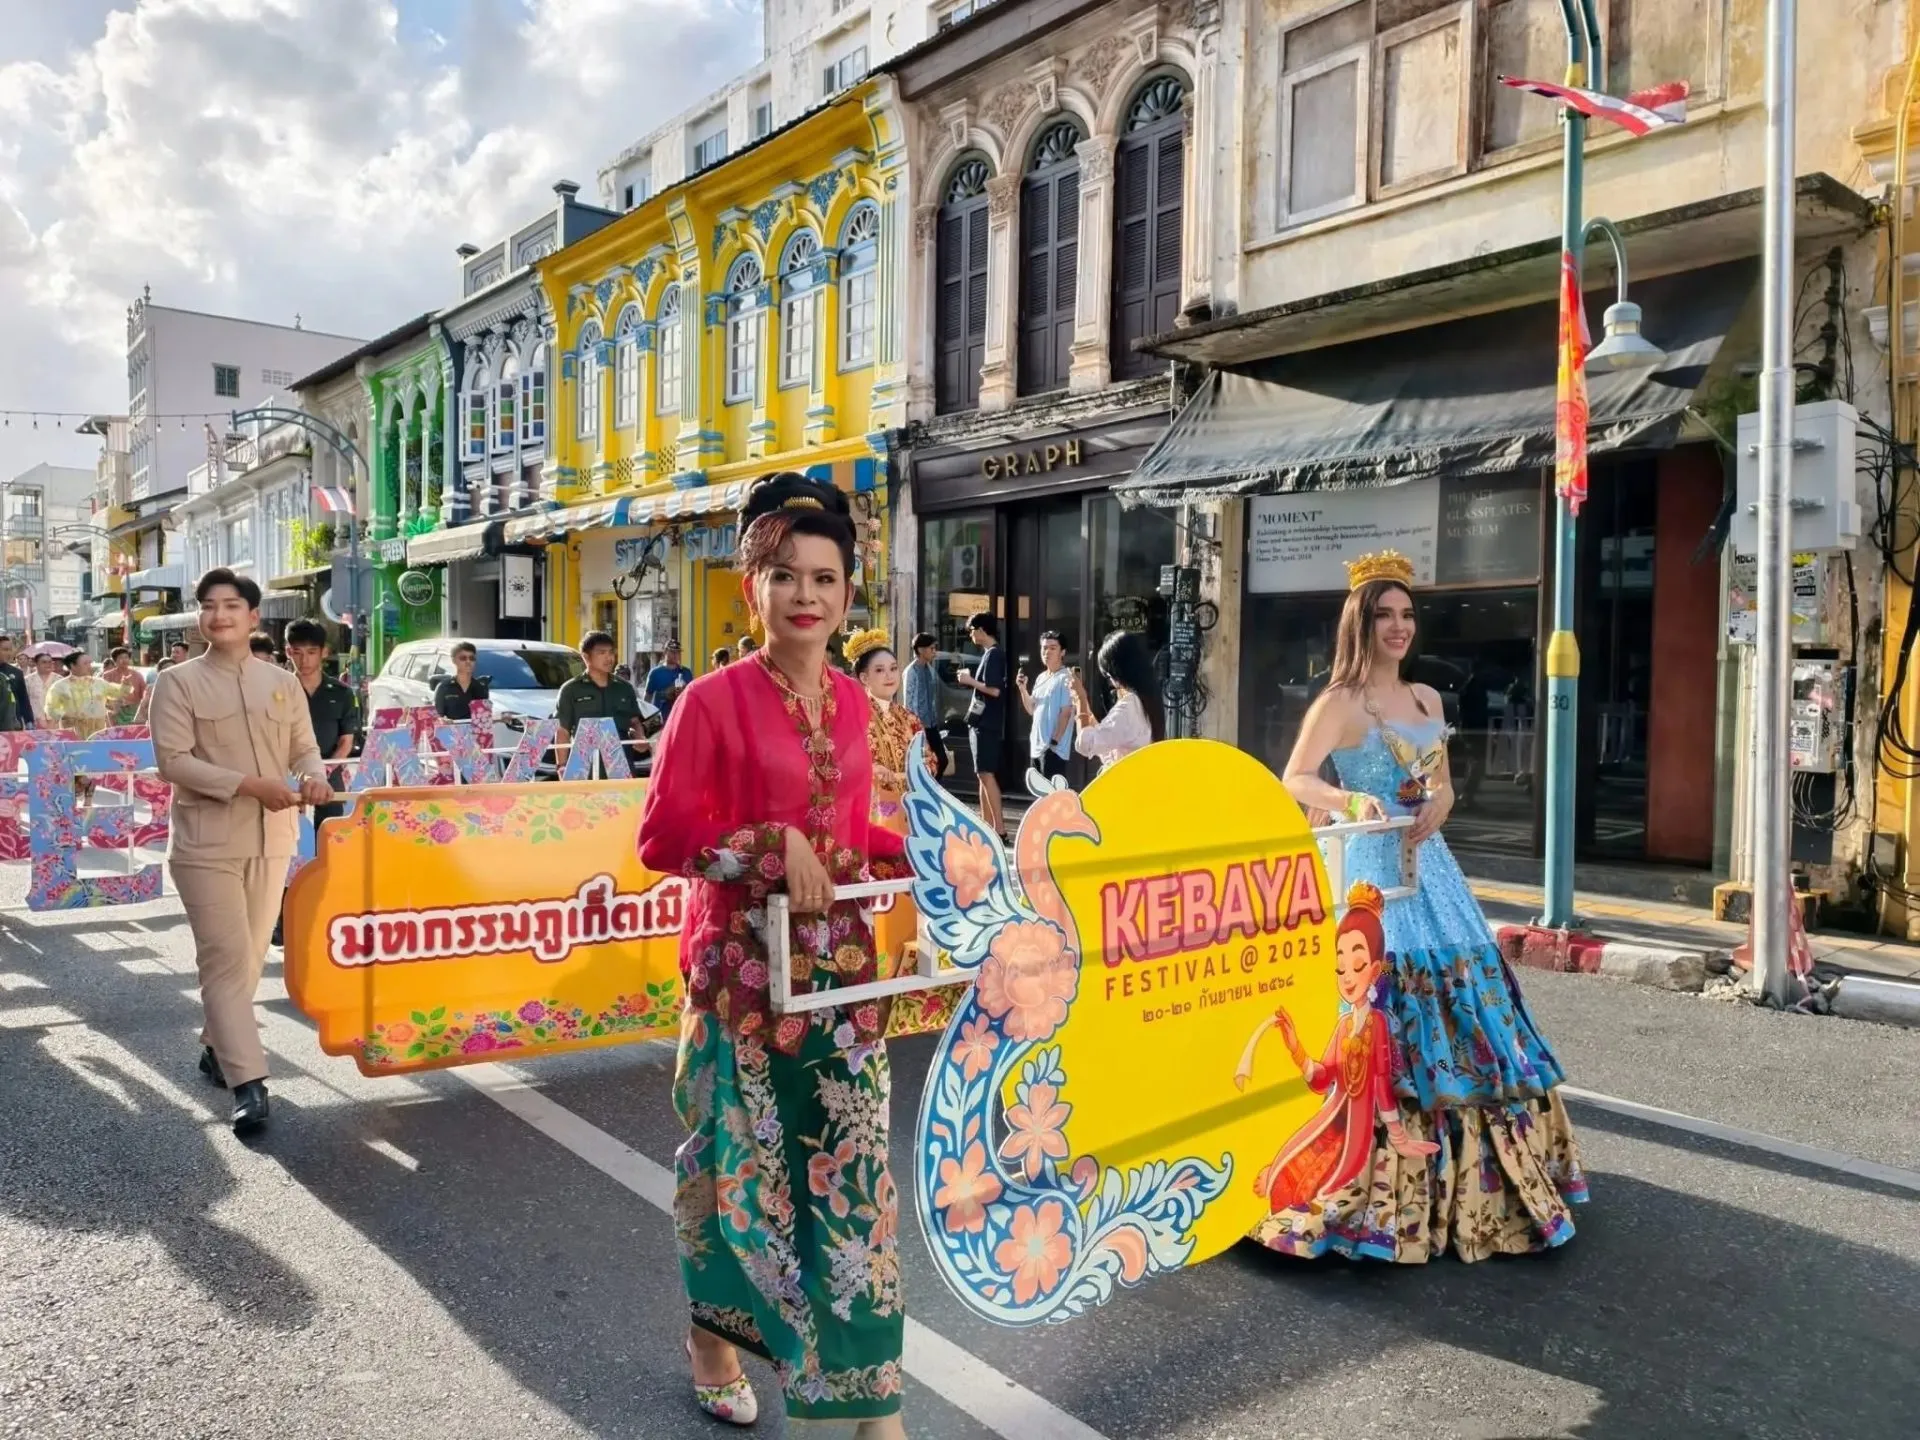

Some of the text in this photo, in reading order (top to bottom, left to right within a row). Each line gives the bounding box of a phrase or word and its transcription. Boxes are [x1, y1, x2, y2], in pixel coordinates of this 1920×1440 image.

[982, 439, 1083, 481] GRAPH
[381, 541, 406, 562] GREEN
[1112, 615, 1148, 628] GRAPH
[1550, 694, 1569, 711] 30
[1100, 853, 1326, 968] KEBAYA
[1105, 934, 1322, 1001] FESTIVAL @ 2025
[1198, 982, 1254, 1010] กันยายน
